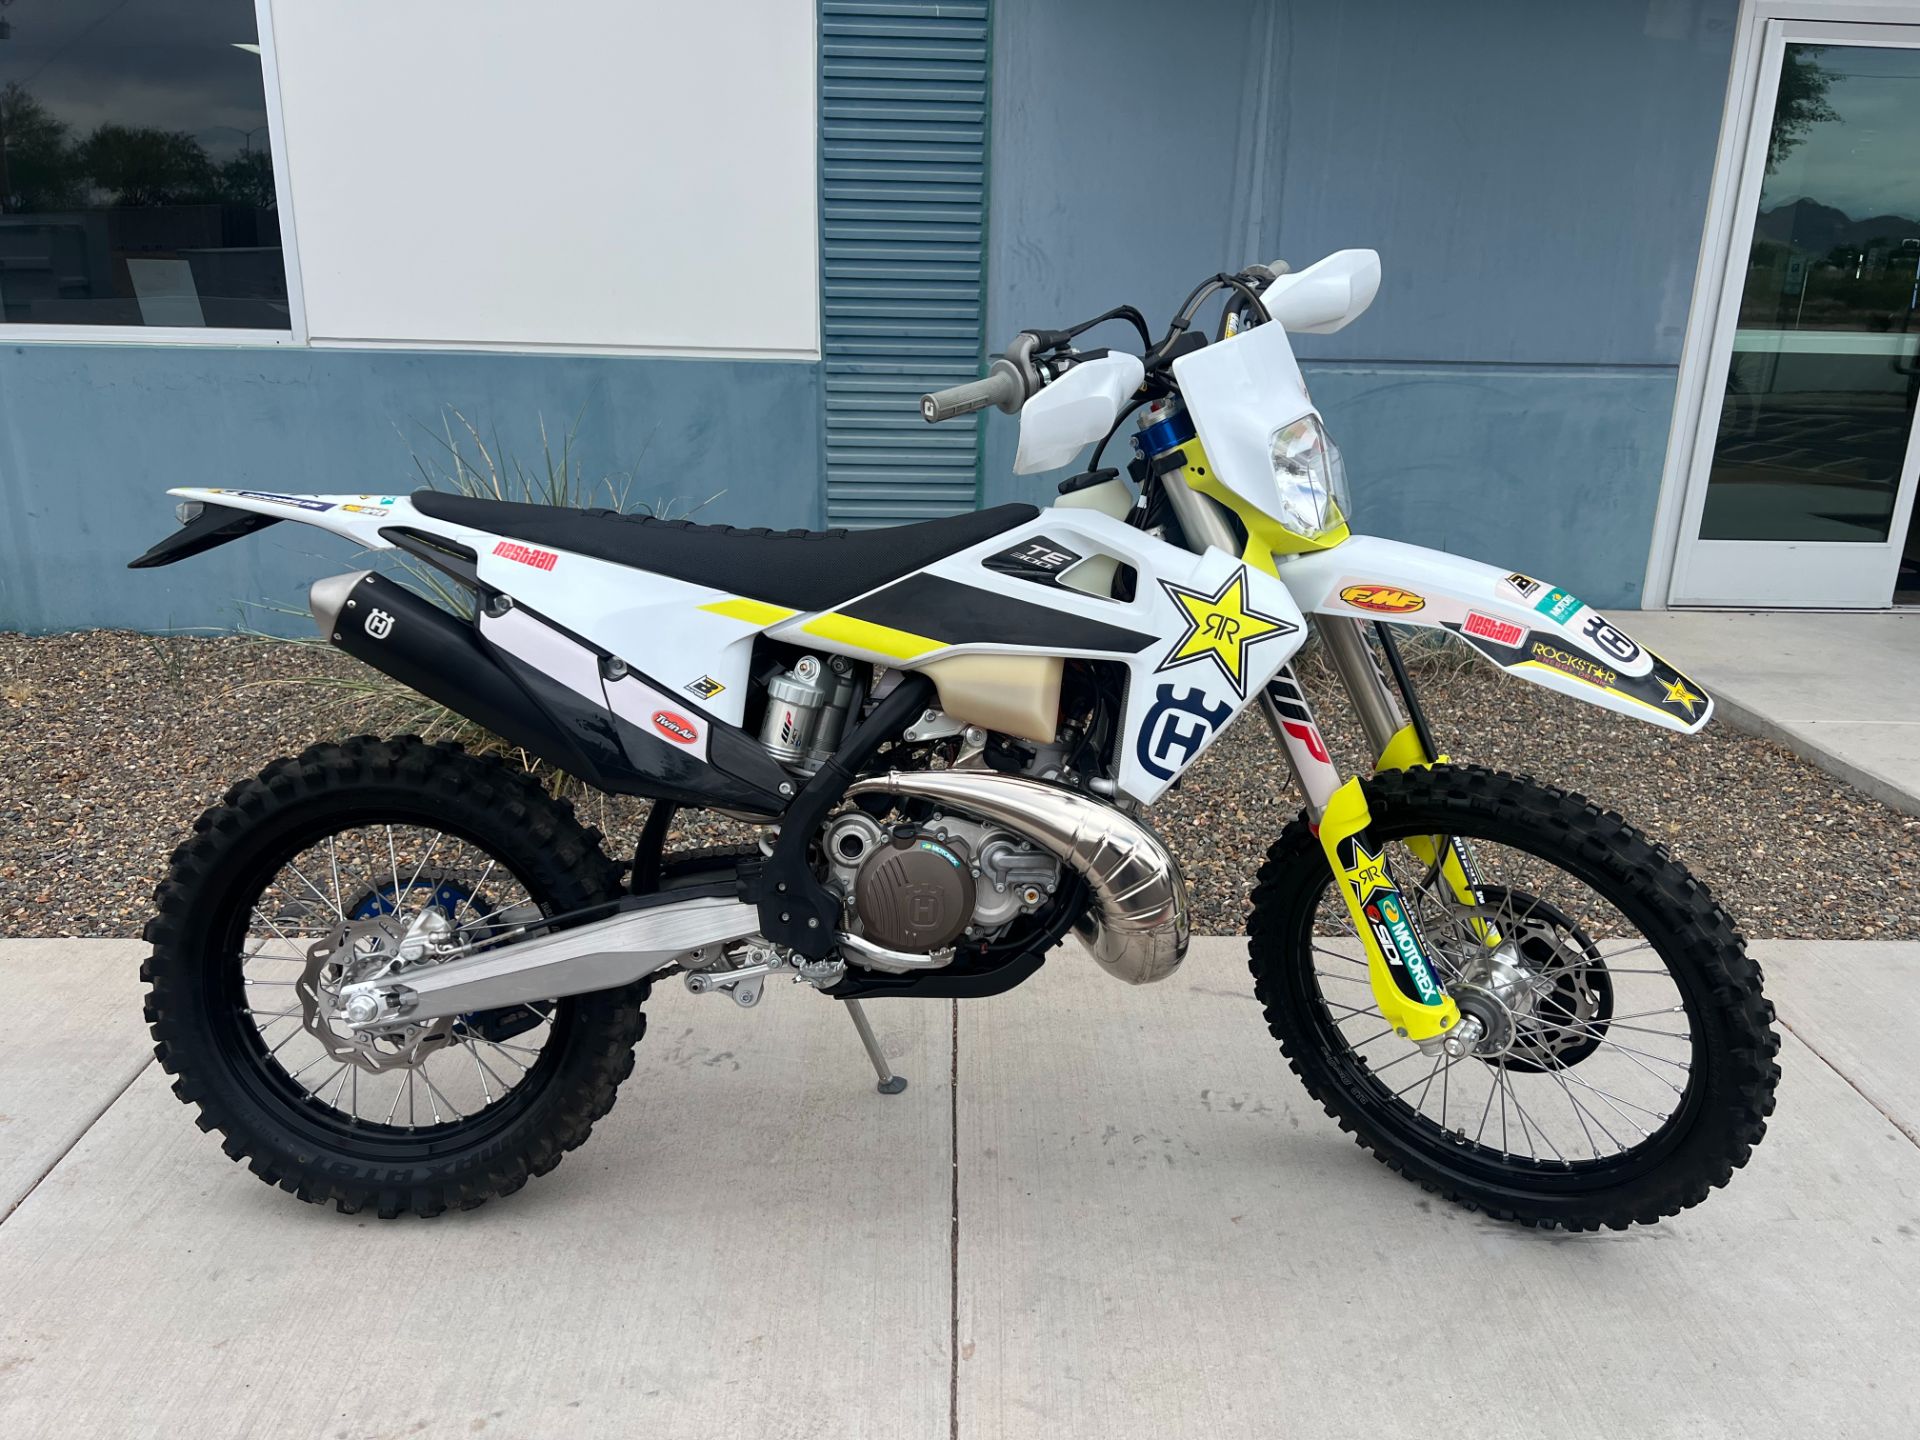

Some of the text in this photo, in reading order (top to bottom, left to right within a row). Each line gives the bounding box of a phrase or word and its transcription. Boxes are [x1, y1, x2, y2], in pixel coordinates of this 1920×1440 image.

[1026, 544, 1073, 566] TE
[1340, 588, 1425, 608] FMF
[656, 714, 680, 732] Twin
[1392, 921, 1437, 1002] MOTOREX
